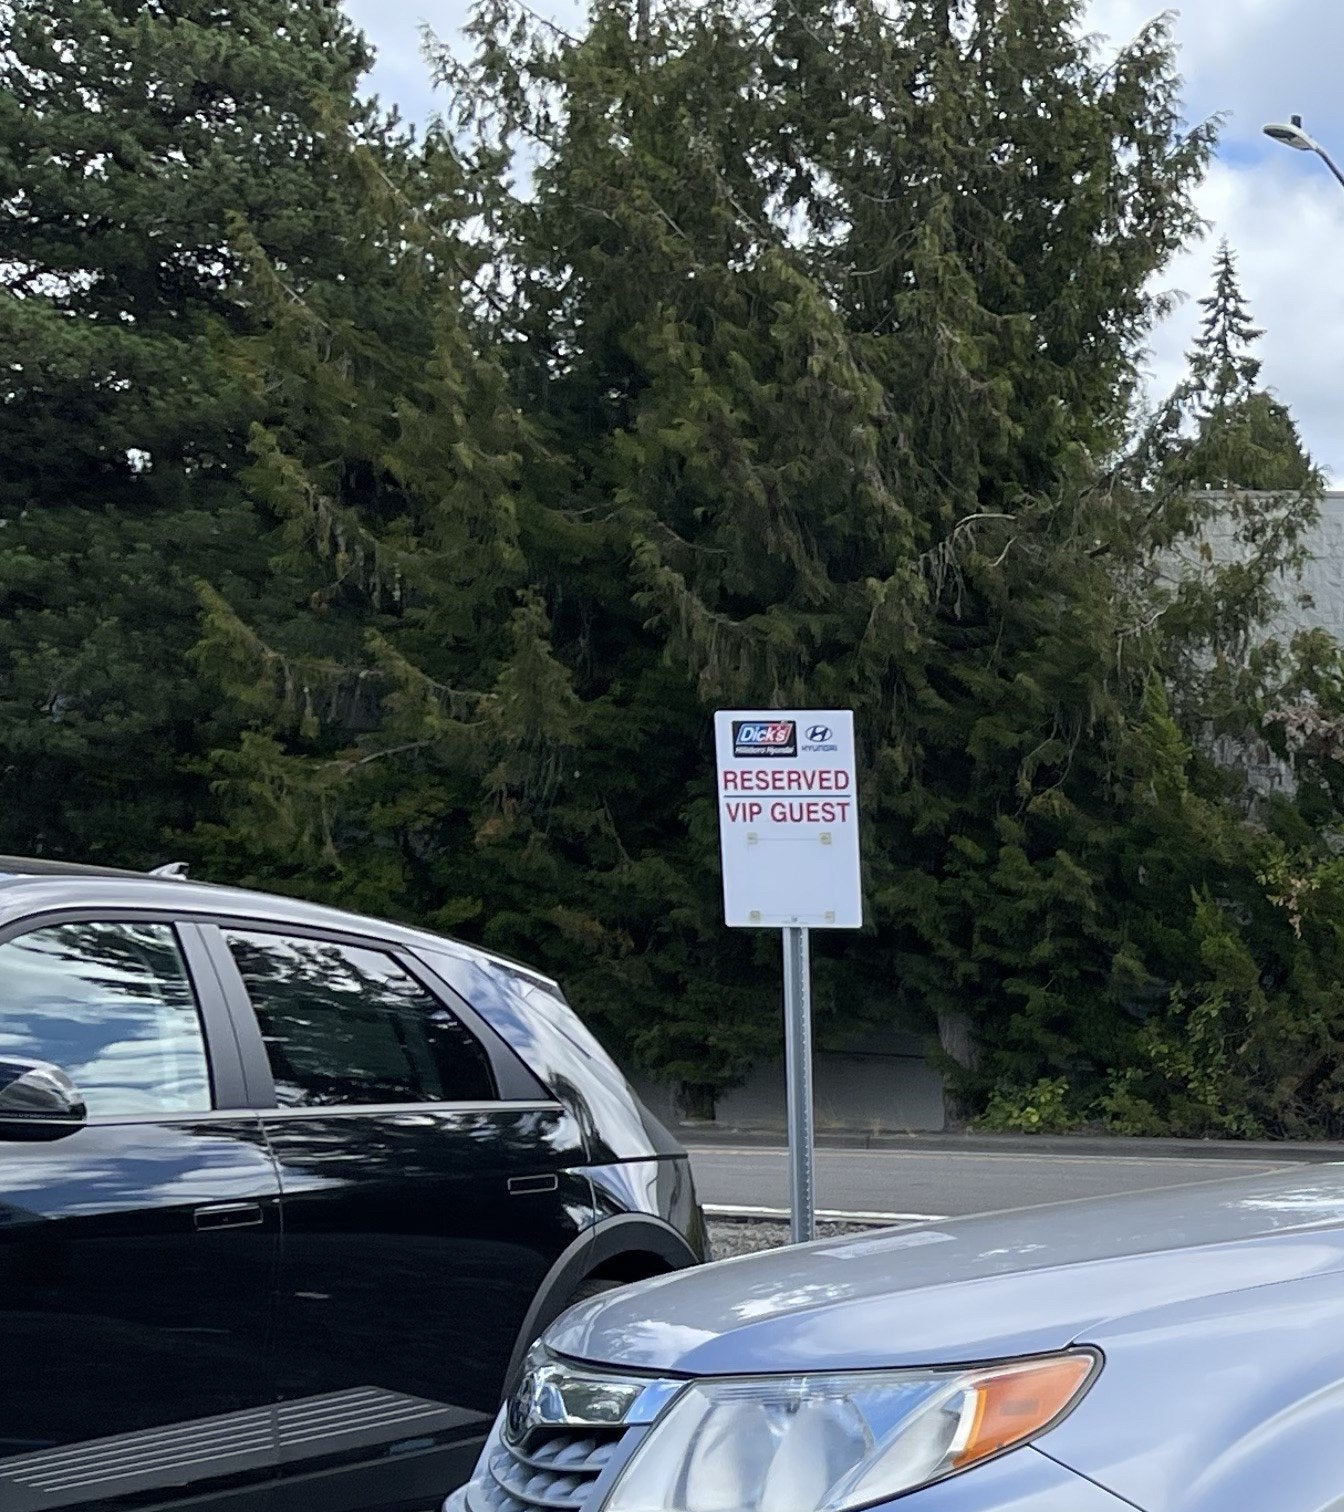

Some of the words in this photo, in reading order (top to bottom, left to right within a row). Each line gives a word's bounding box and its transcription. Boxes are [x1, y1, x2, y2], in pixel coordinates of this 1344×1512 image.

[723, 769, 850, 791] RESERVED
[726, 802, 762, 823] VIP
[770, 802, 851, 823] GUEST
